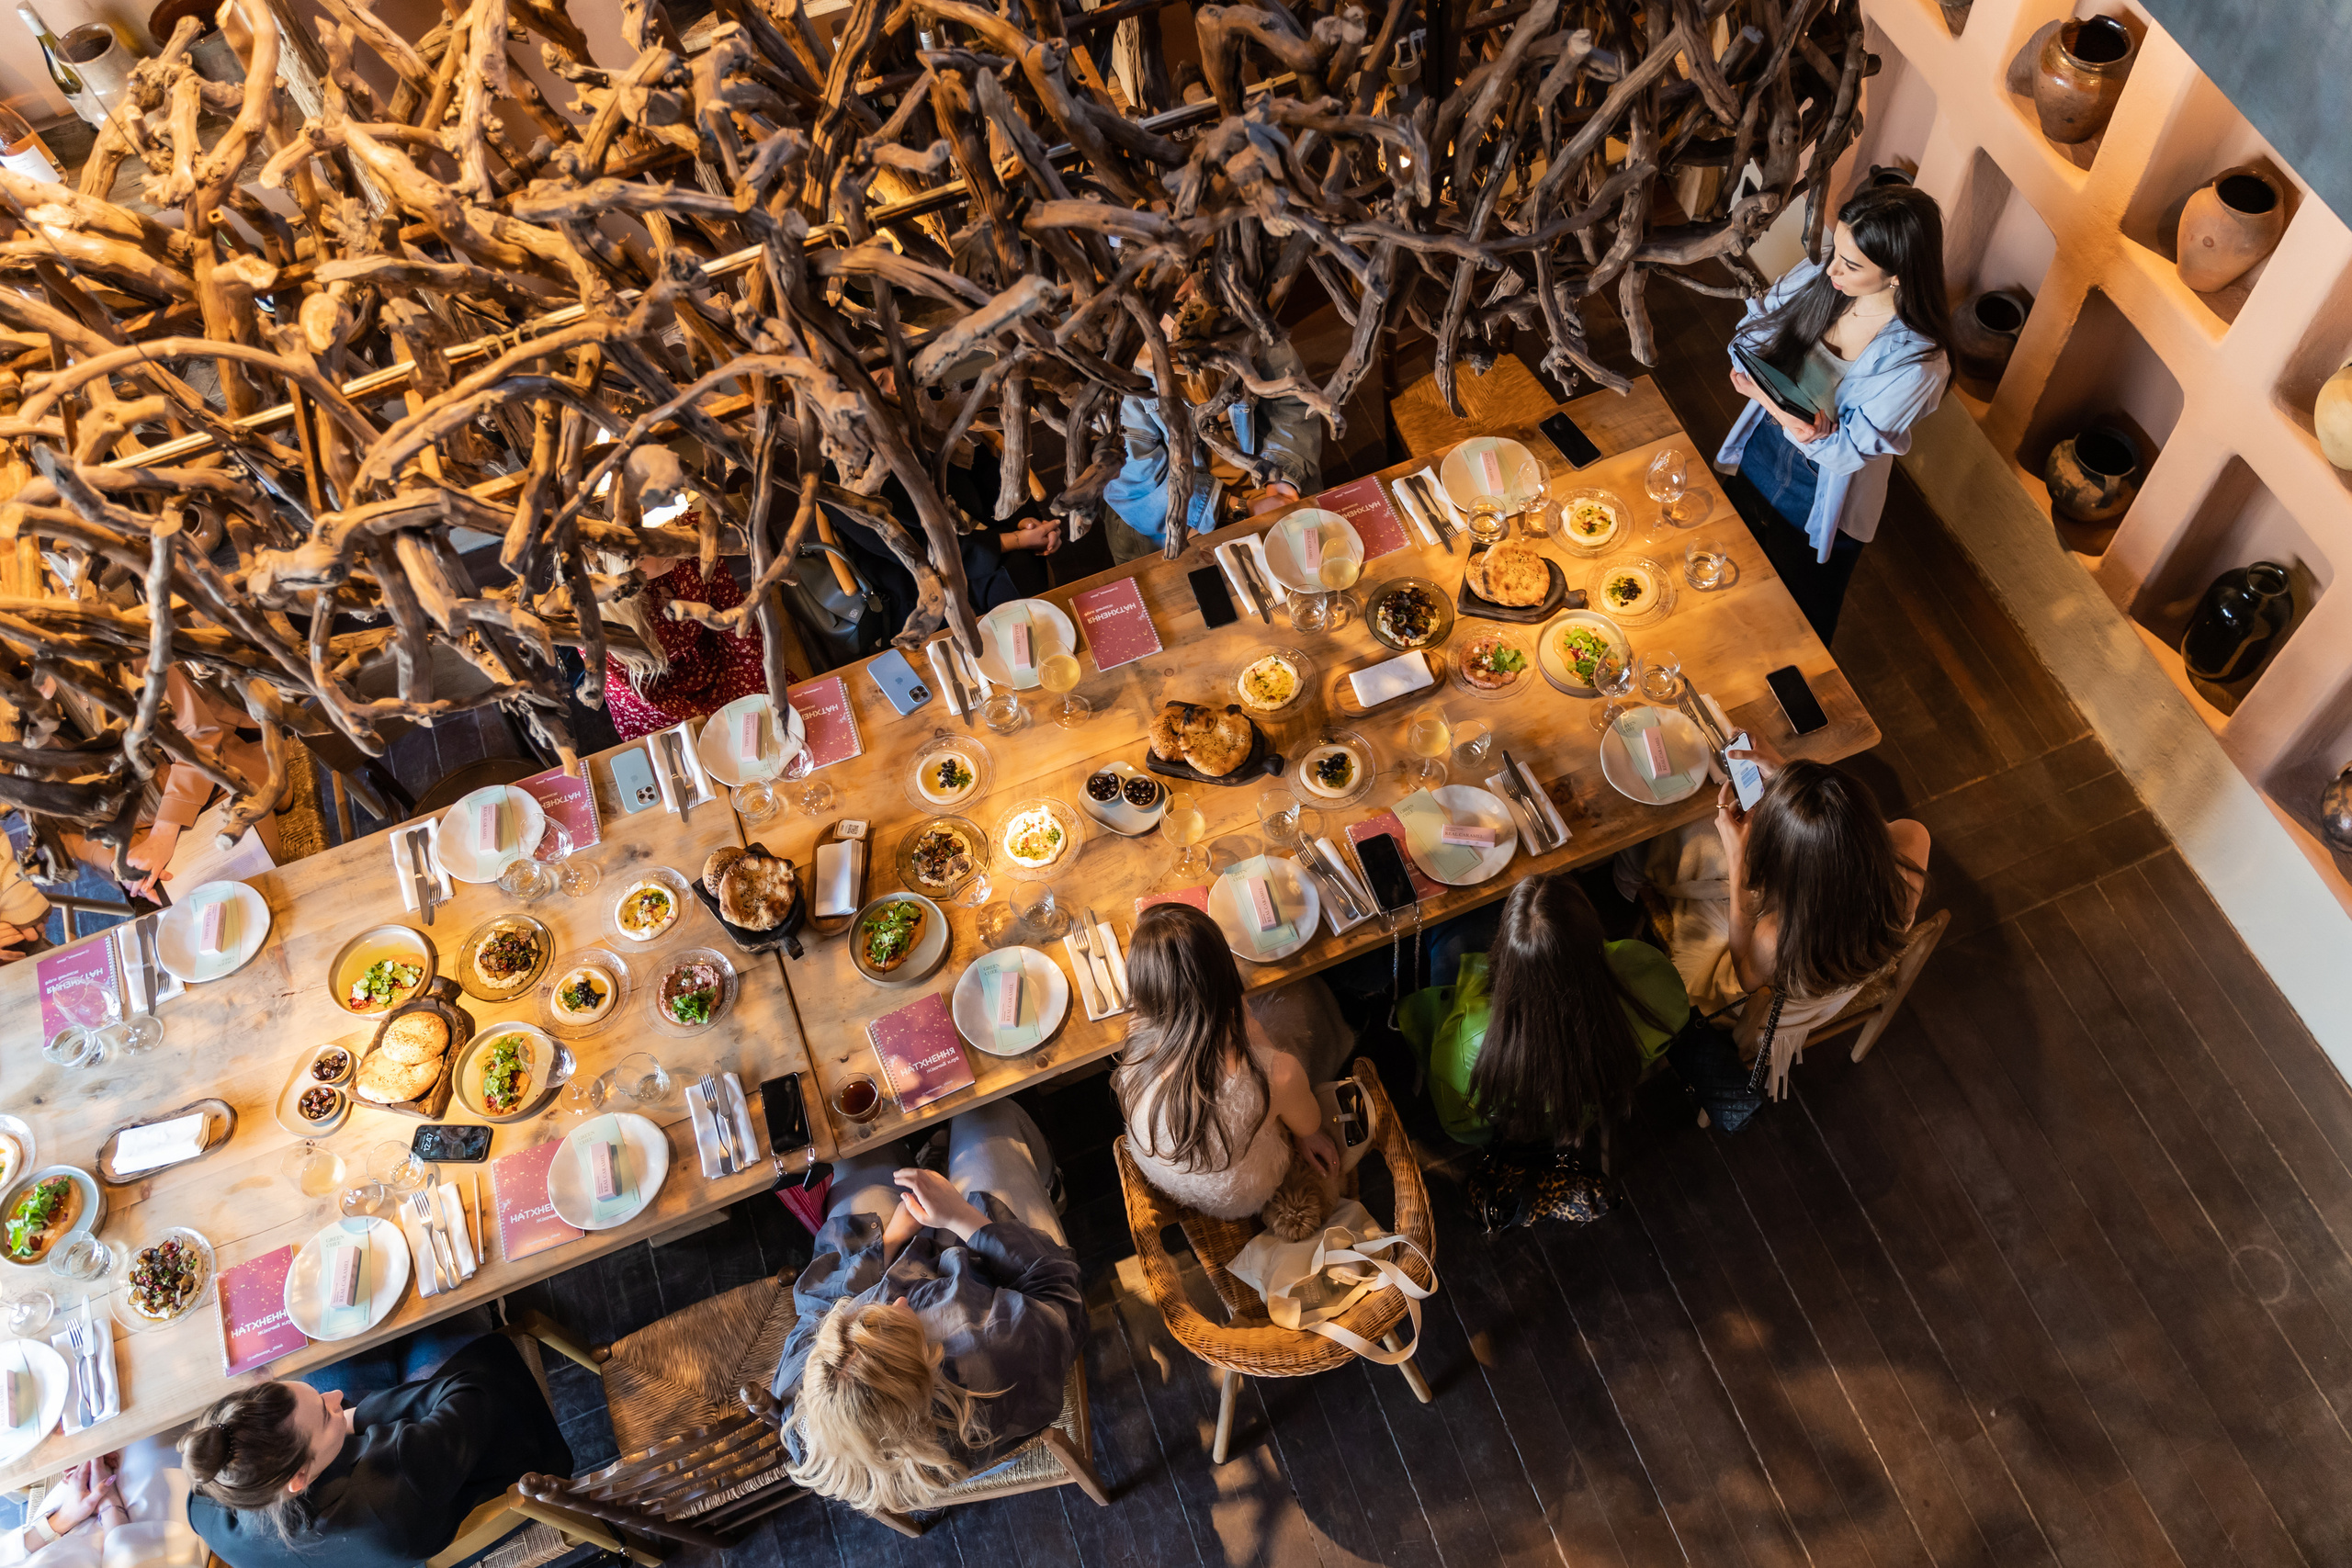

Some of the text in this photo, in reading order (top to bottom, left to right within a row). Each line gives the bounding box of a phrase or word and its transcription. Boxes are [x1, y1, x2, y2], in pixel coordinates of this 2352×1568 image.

[1341, 501, 1381, 519] НАТХНЕН
[1087, 603, 1136, 624] НАТХНЕННЯ
[802, 704, 839, 721] НАТХНЕ
[541, 791, 582, 809] НАТХНЕН
[900, 1047, 956, 1077] НАТХНЕННЯ
[424, 1133, 434, 1152] 12:47
[510, 1203, 554, 1224] НАТХНЕН
[231, 1309, 289, 1339] НАТХНЕНН
[281, 1319, 293, 1328] клу
